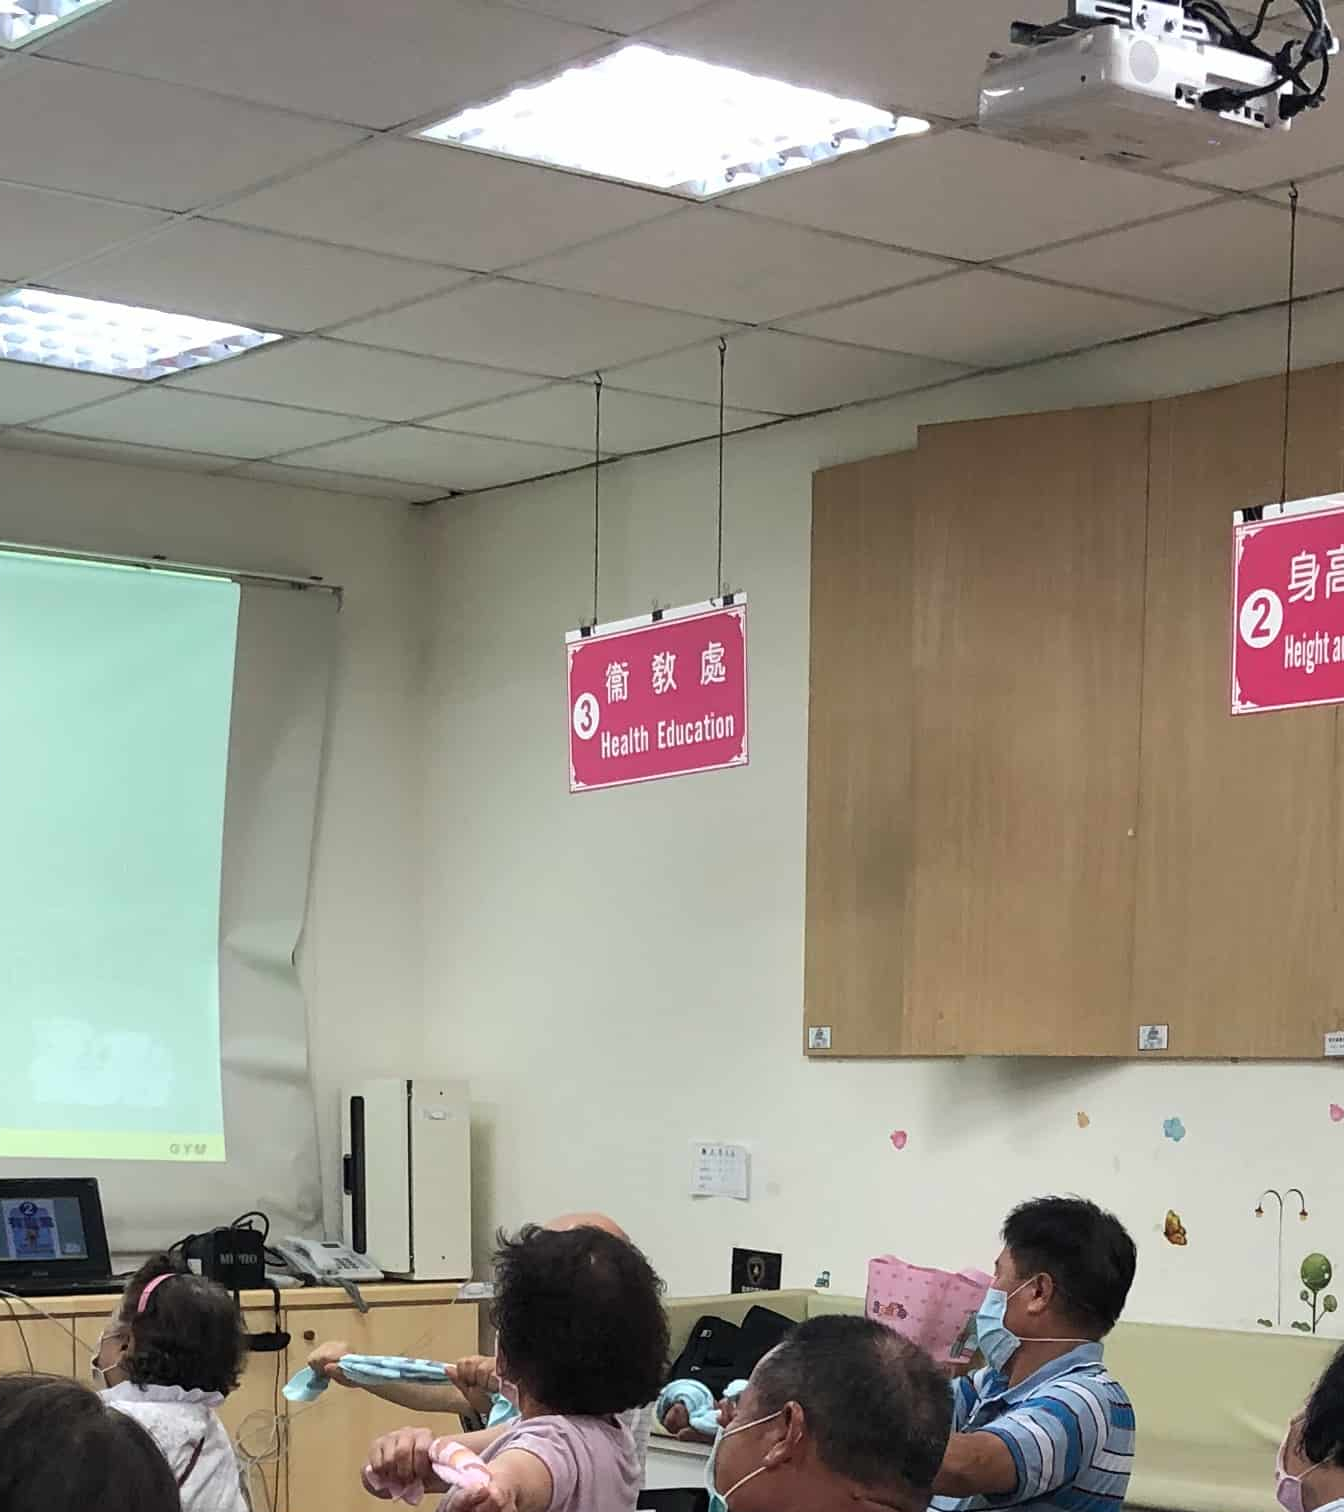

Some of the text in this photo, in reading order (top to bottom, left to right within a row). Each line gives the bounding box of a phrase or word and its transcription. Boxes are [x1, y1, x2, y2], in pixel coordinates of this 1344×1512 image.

[1251, 597, 1272, 639] 2
[1284, 627, 1330, 674] Height
[580, 700, 593, 733] 3
[601, 712, 734, 759] Health Education
